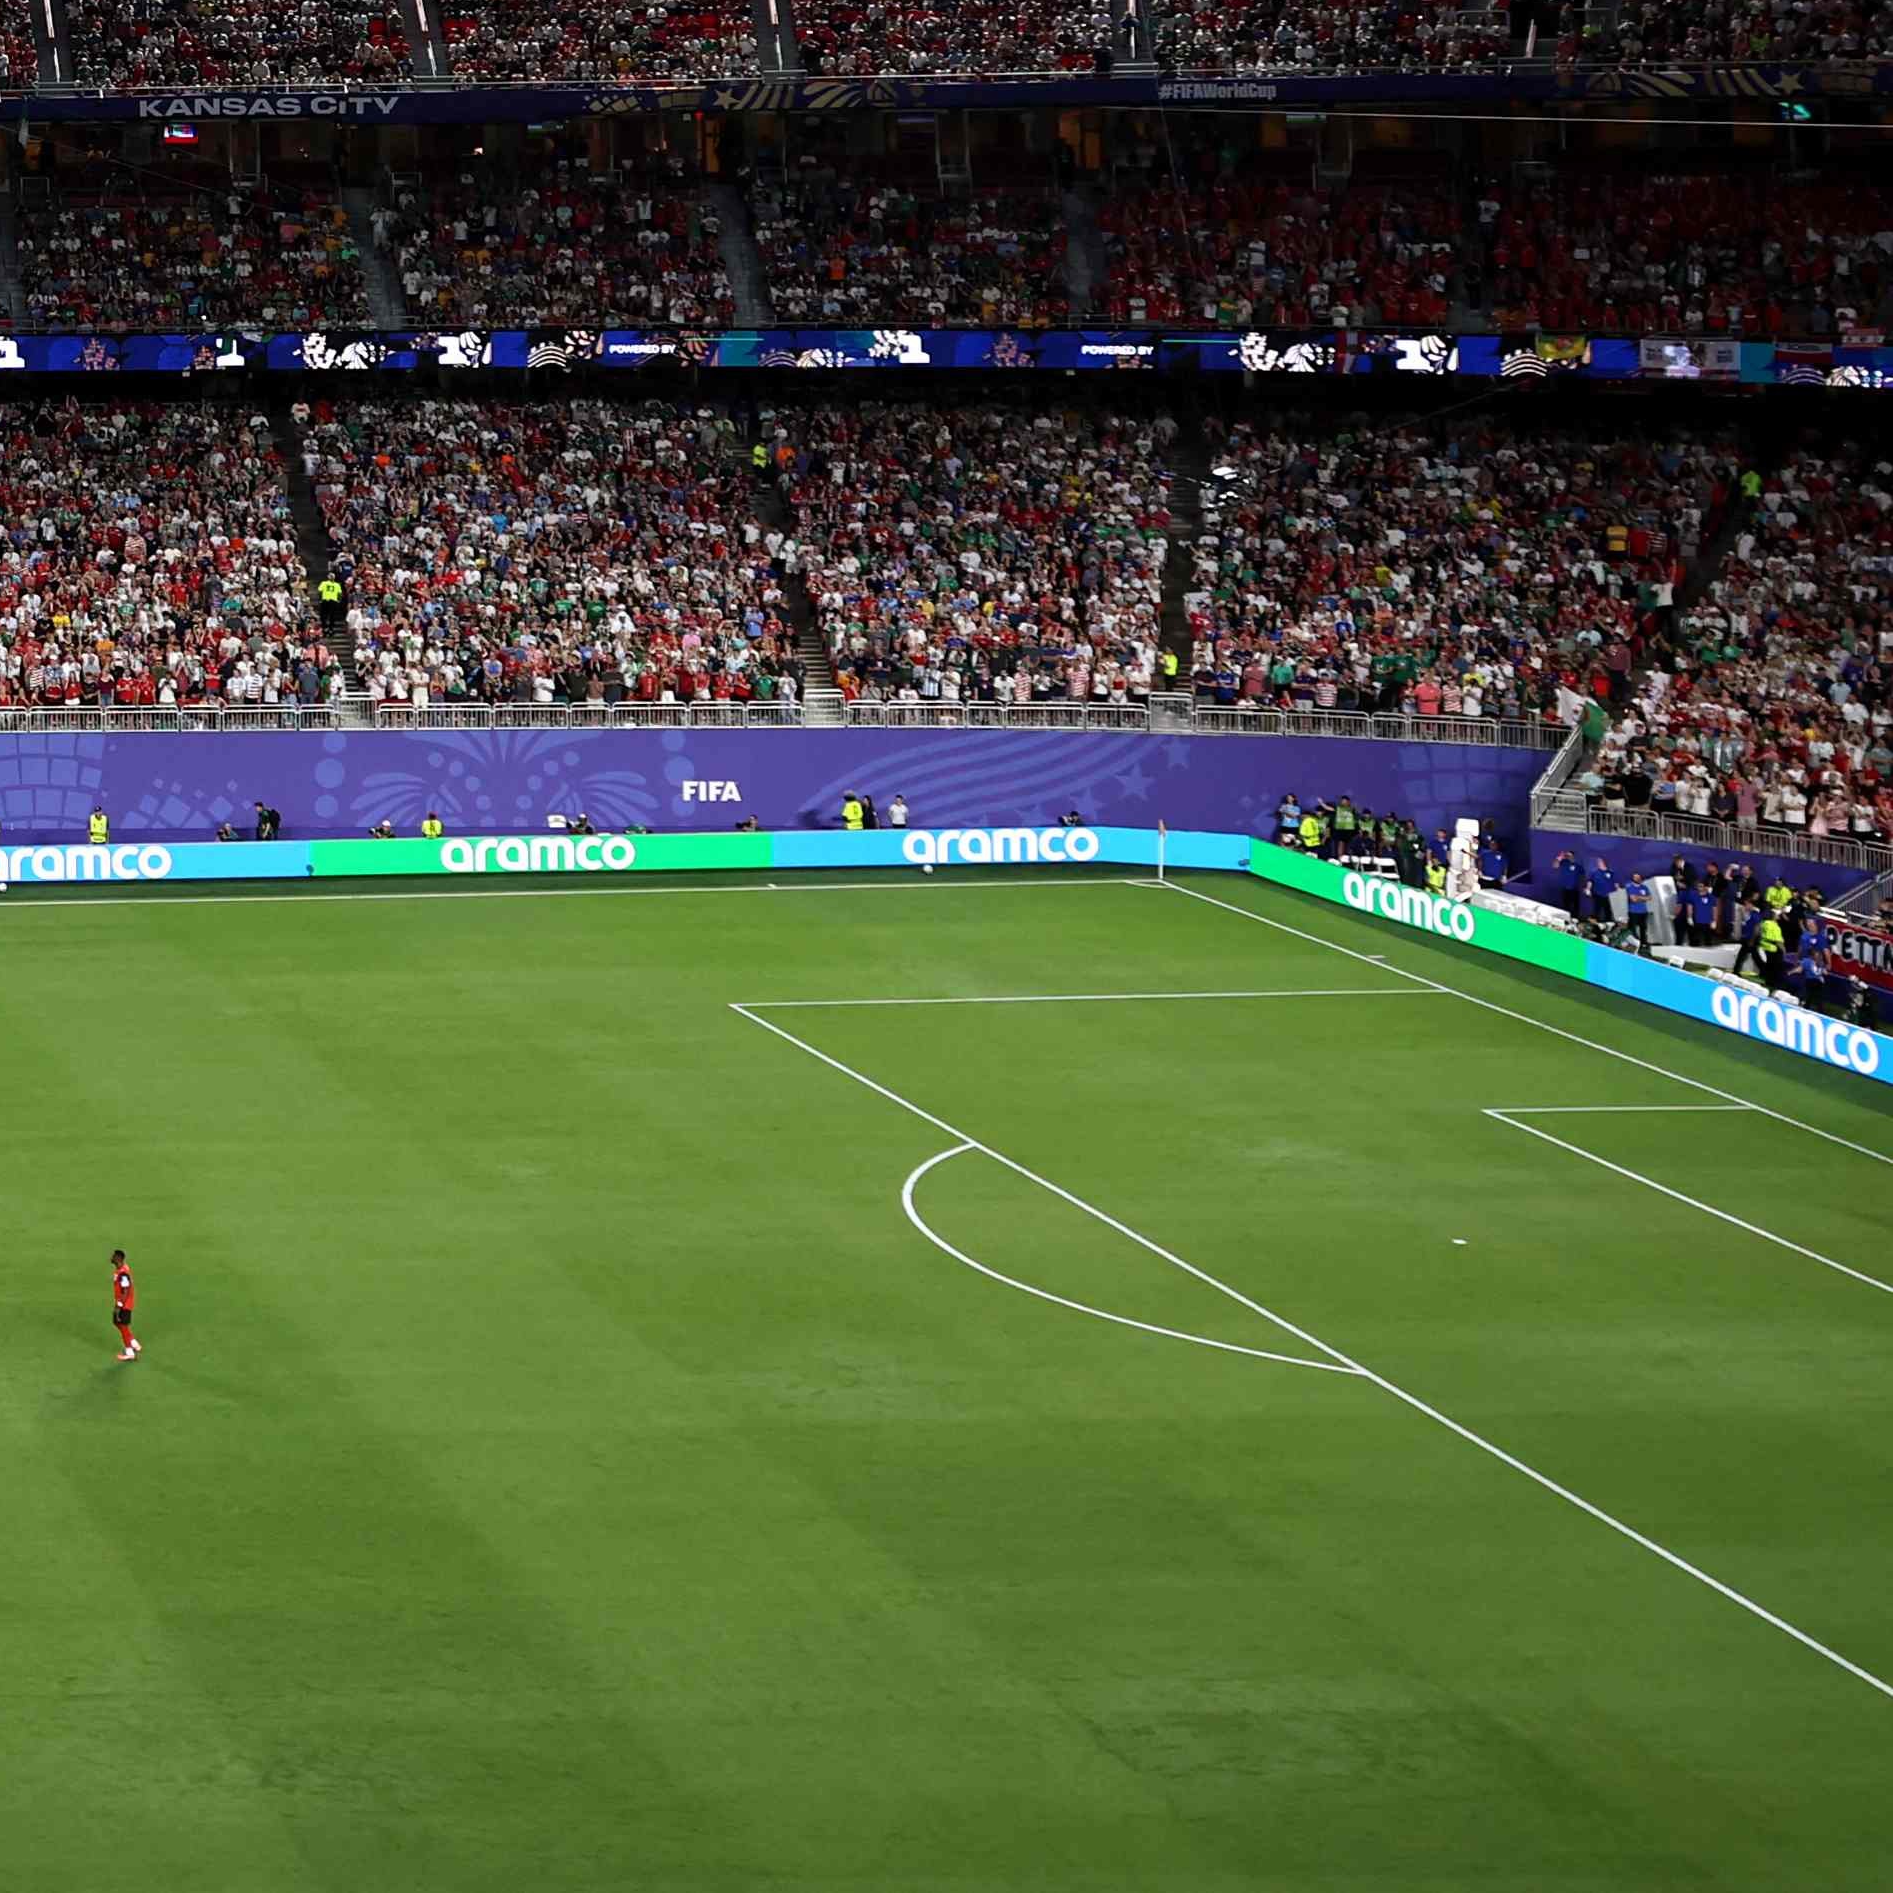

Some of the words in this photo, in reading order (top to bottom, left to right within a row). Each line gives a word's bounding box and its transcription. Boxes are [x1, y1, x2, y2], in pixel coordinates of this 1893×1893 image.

[1158, 83, 1277, 100] #FIFAWorldCup
[139, 98, 301, 117] KANSAS
[310, 96, 399, 114] CITY
[661, 344, 676, 354] BY
[1137, 346, 1154, 355] BY
[682, 780, 741, 802] FIFA
[442, 836, 634, 872] aramco
[904, 829, 1098, 863] aramco
[1344, 872, 1474, 941] aramco
[1711, 986, 1879, 1075] aramco
